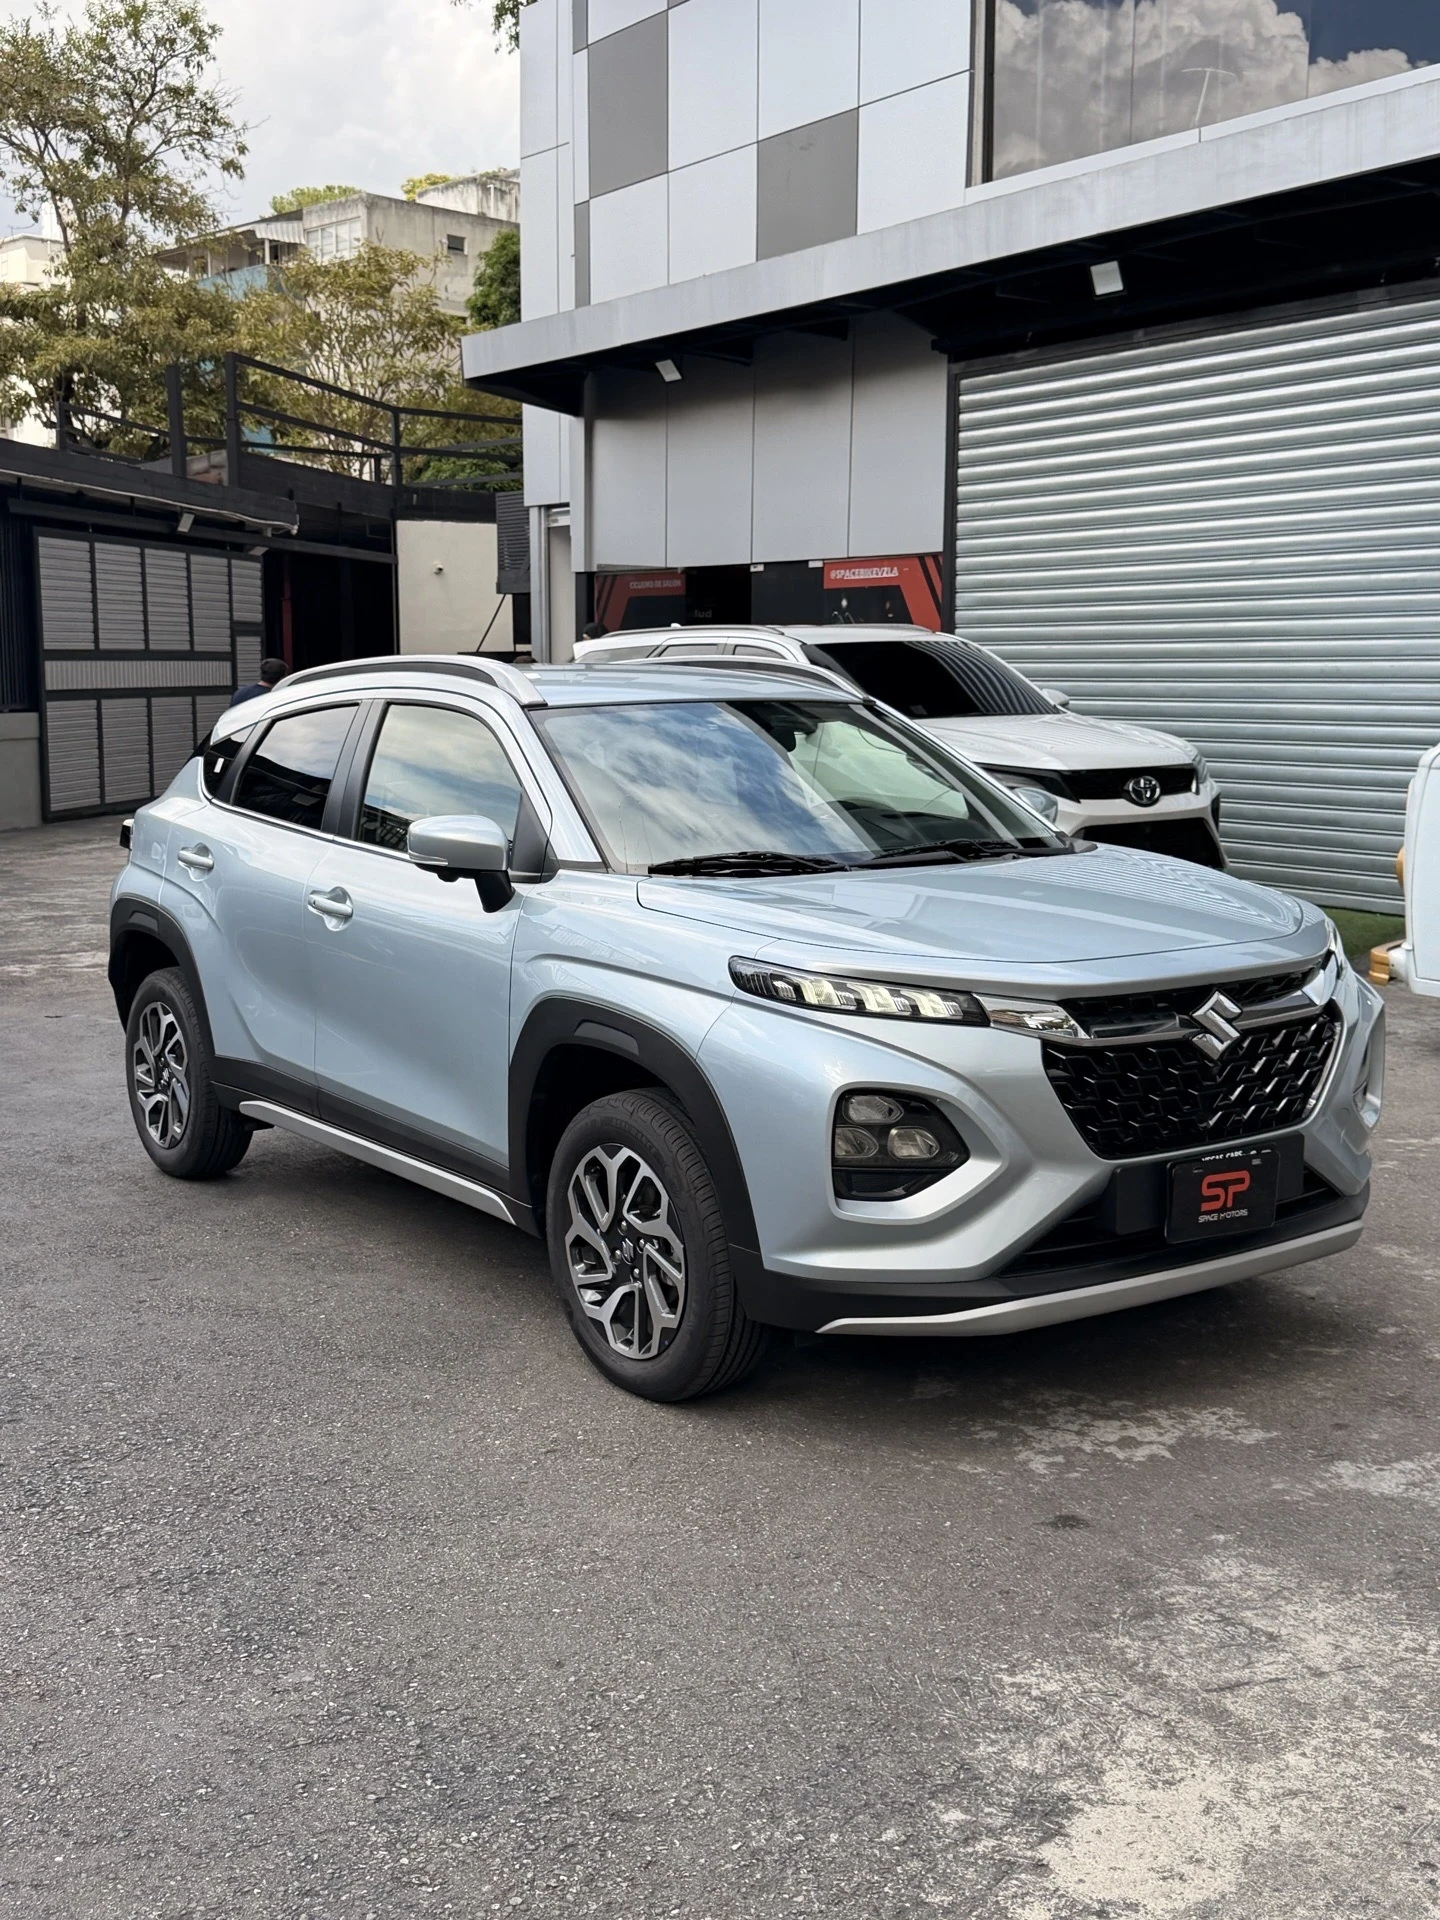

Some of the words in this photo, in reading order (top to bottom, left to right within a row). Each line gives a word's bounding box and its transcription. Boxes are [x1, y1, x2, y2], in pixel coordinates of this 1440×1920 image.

[1201, 1170, 1250, 1212] SP
[1198, 1213, 1218, 1223] SPACE
[1219, 1209, 1248, 1219] MOTORS
